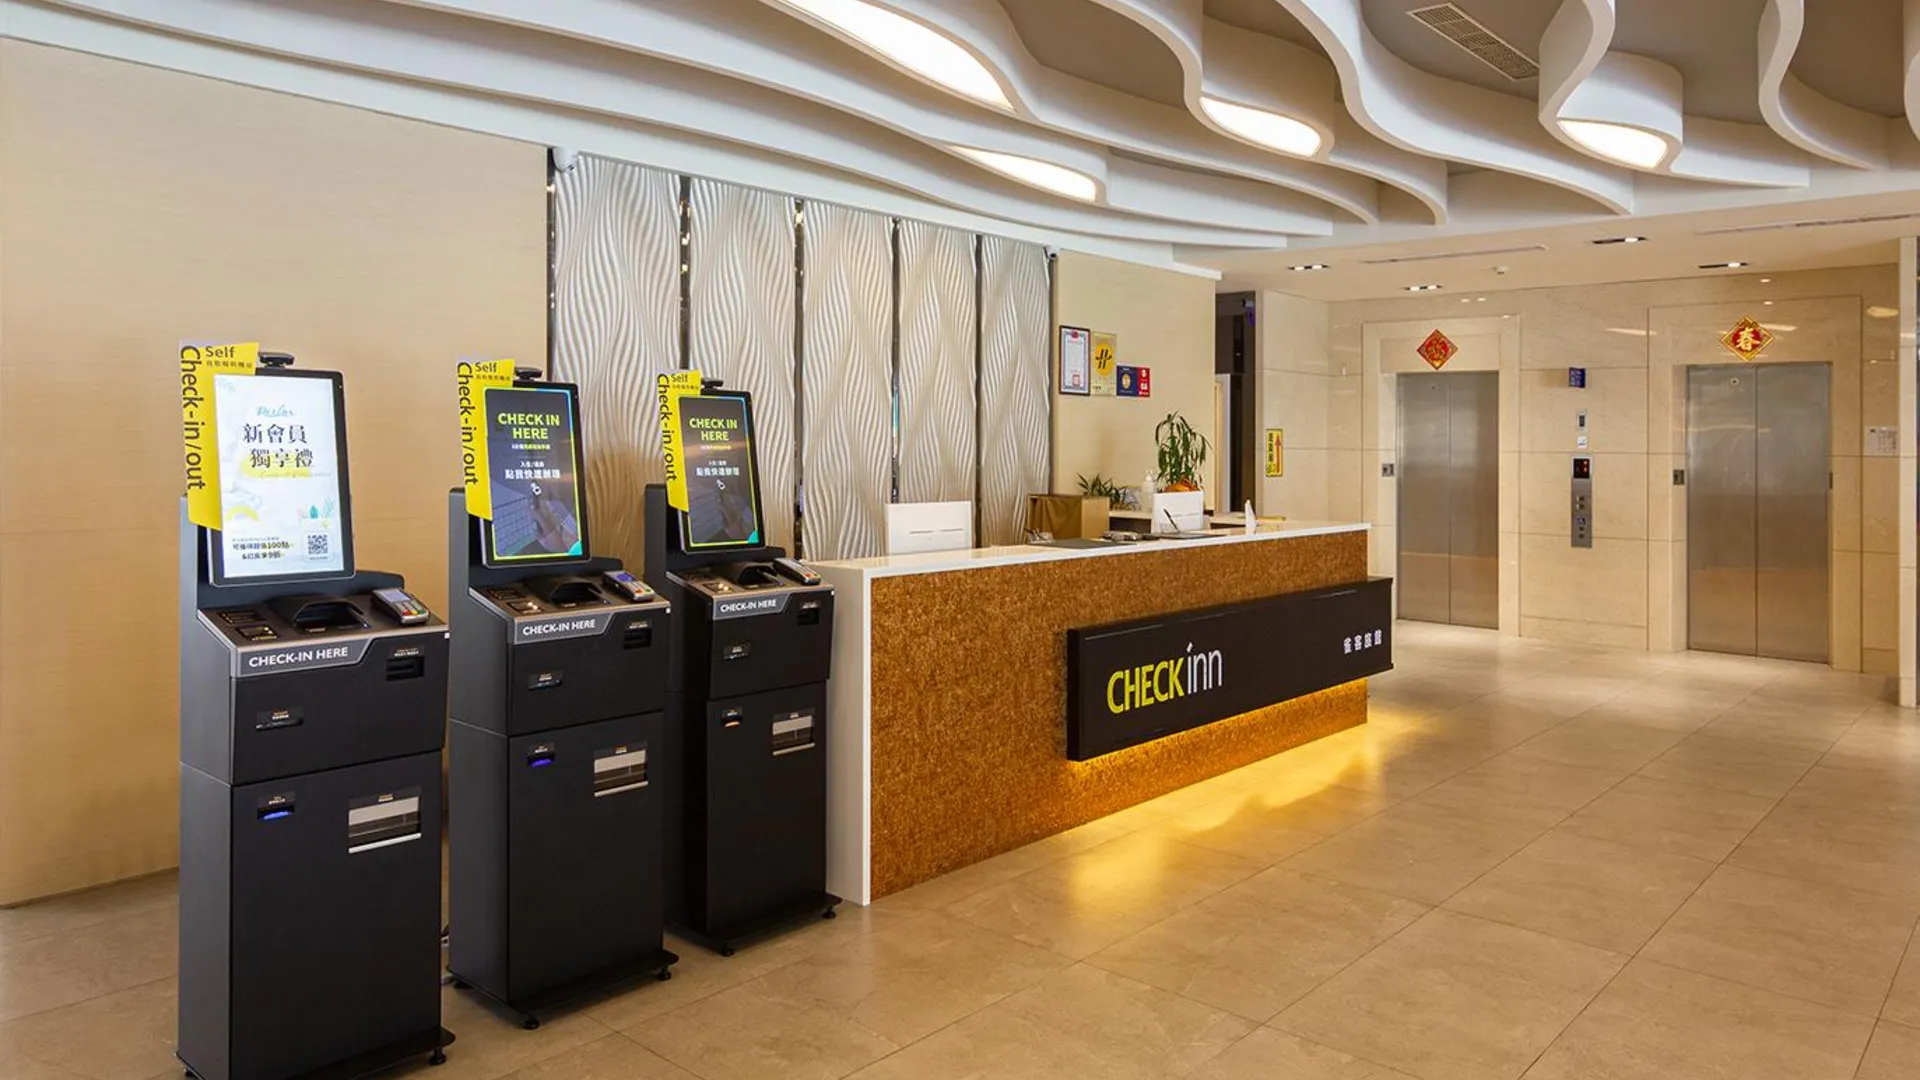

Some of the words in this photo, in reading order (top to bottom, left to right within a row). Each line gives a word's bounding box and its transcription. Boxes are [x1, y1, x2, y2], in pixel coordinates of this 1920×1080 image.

[1735, 327, 1760, 351] 春
[205, 346, 235, 358] Self
[475, 362, 497, 373] Self
[671, 374, 688, 383] Self
[180, 345, 205, 490] Check-in/out
[457, 362, 479, 486] Check-in/out
[498, 413, 543, 425] CHECK
[547, 414, 560, 426] IN
[689, 418, 724, 429] CHECK
[726, 419, 738, 430] IN
[243, 423, 307, 443] 新會員
[512, 428, 549, 440] HERE
[657, 373, 678, 481] Check-in/out
[701, 431, 729, 441] HERE
[250, 448, 316, 468] 獨享禮
[505, 469, 561, 480] 點我快速辦理
[720, 601, 756, 613] CHECK-IN
[758, 599, 777, 608] HERE
[522, 622, 570, 636] CHECK-IN
[571, 619, 596, 630] HERE
[249, 650, 313, 667] CHECK-IN
[316, 647, 348, 659] HERE
[1107, 657, 1185, 714] CHECK
[1186, 642, 1223, 695] inn
